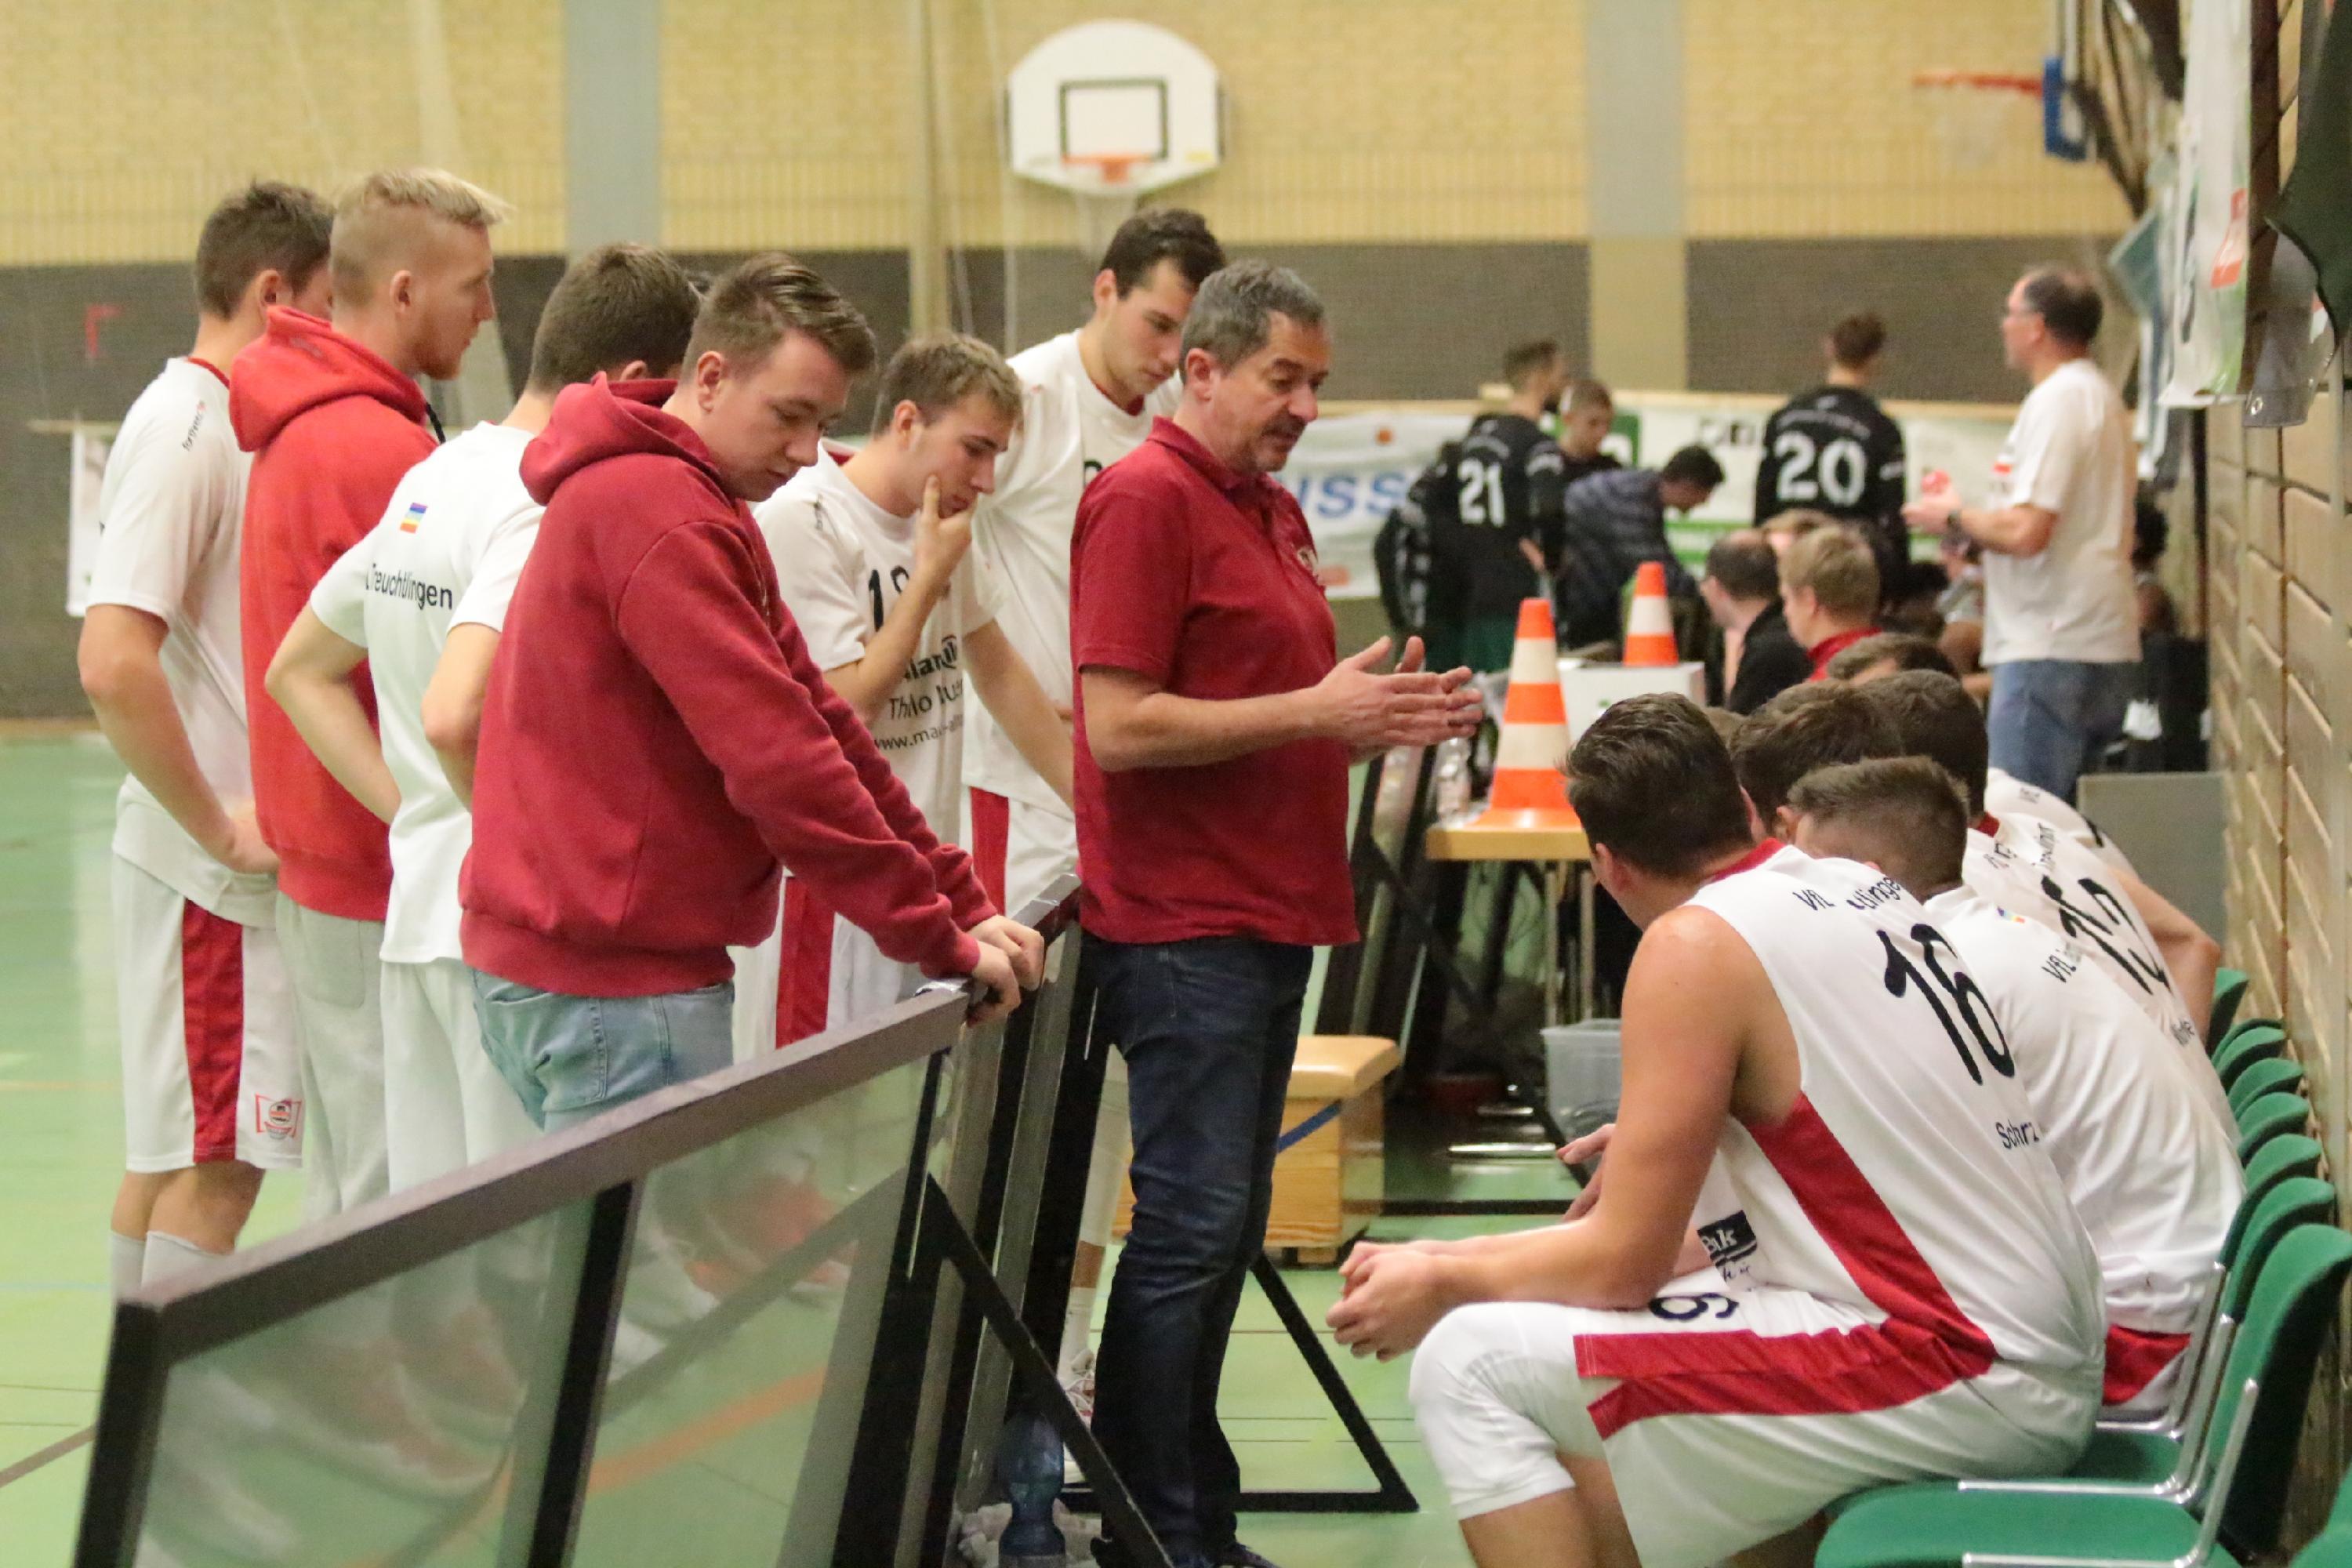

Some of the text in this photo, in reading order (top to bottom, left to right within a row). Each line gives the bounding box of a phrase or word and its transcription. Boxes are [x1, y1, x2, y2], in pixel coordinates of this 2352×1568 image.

[1457, 457, 1506, 528] 21
[1773, 430, 1867, 507] 20
[1876, 924, 2015, 1086] 16
